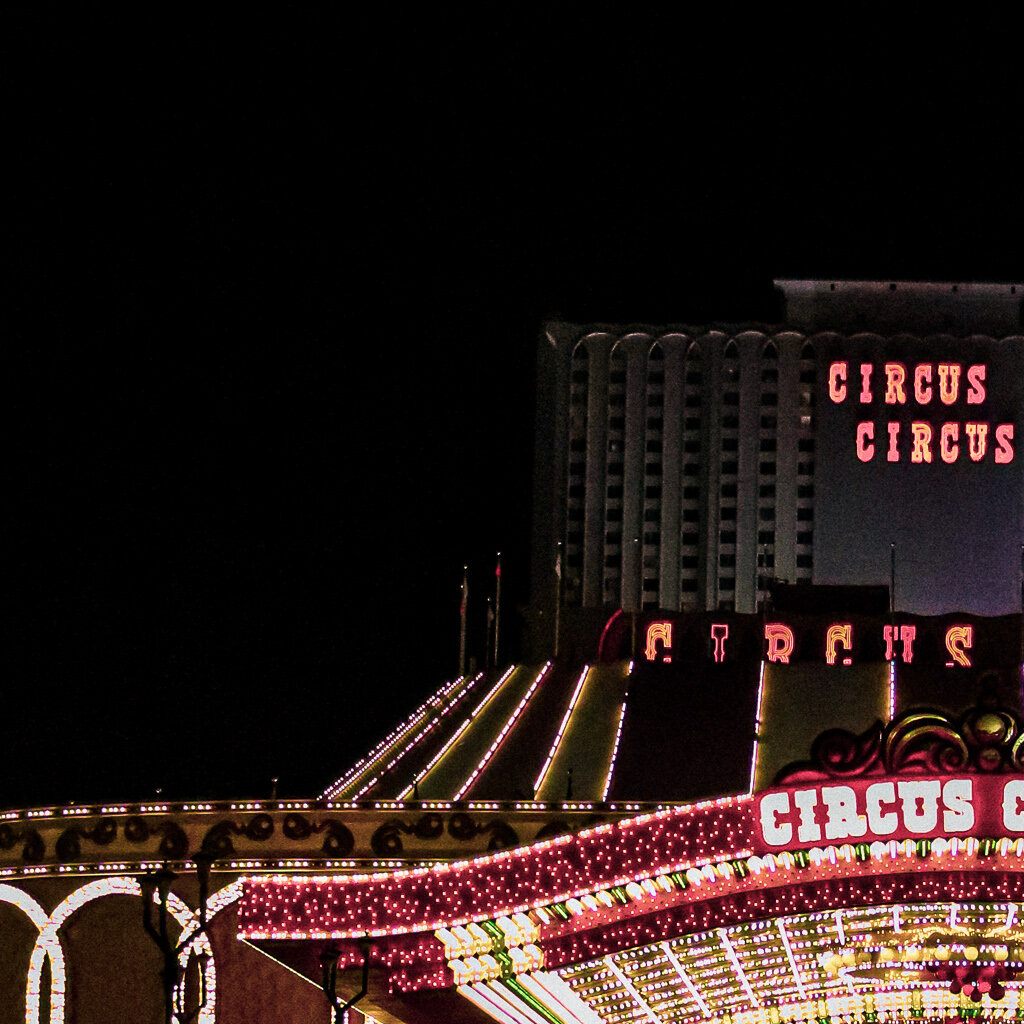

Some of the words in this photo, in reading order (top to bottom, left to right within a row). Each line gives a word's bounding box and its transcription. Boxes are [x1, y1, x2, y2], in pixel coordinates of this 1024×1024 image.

[829, 362, 986, 405] CIRCUS
[856, 421, 1014, 464] CIRCUS
[759, 780, 976, 846] CIRCUS
